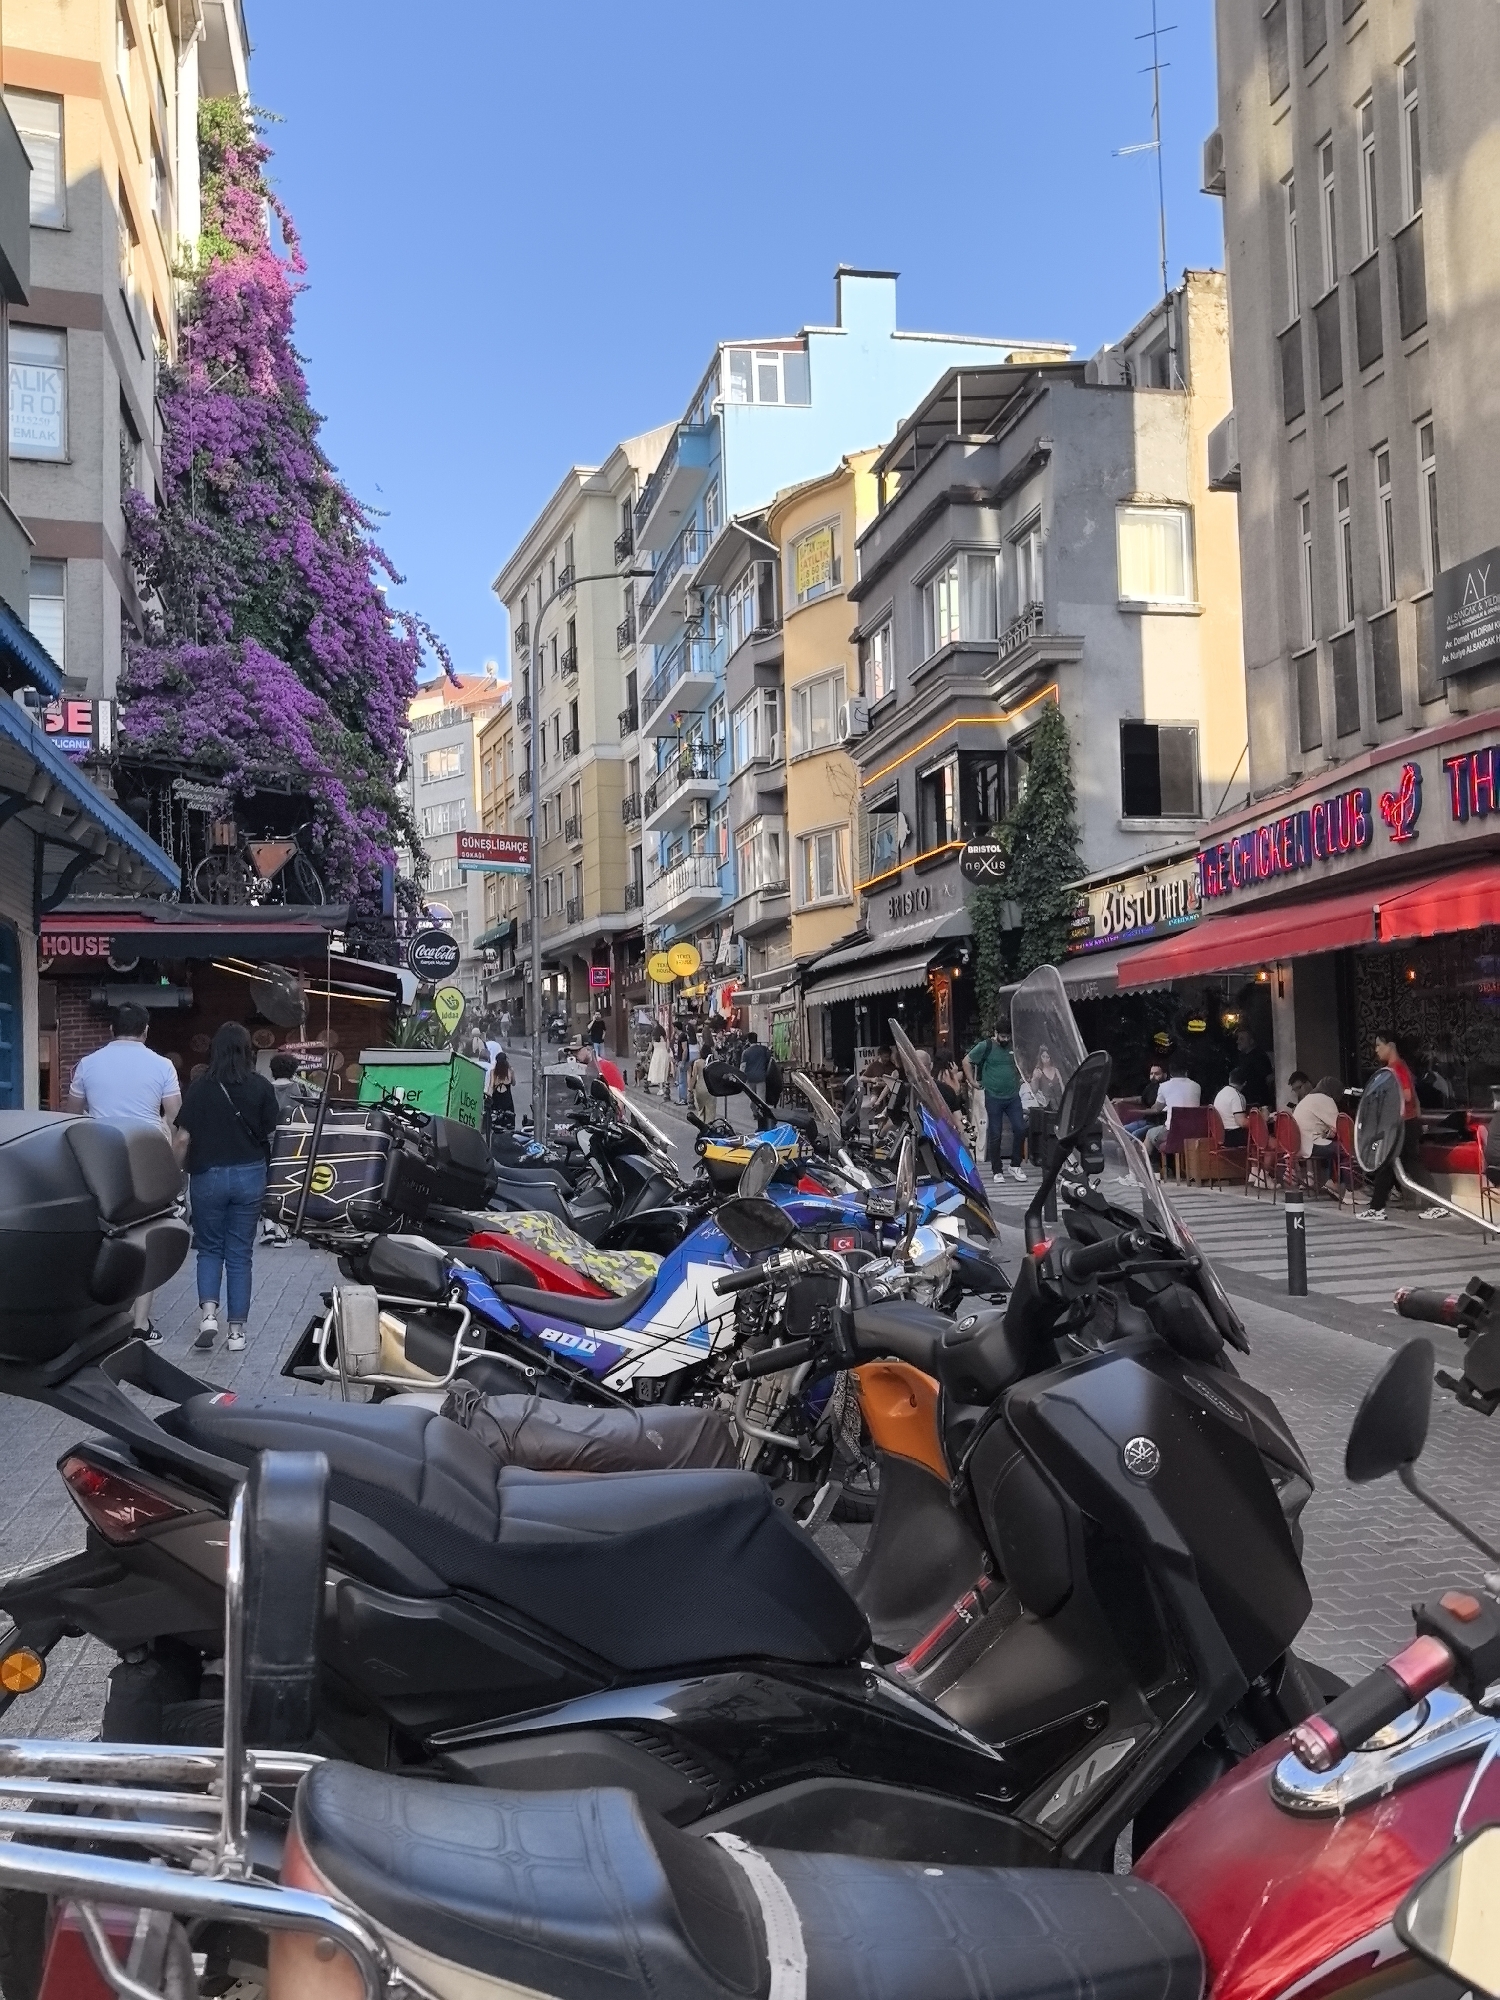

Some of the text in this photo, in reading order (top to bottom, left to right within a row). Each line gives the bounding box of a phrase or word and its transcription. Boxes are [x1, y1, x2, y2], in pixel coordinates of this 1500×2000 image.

[13, 427, 56, 441] EMLAK
[1463, 563, 1491, 606] AY
[1446, 603, 1478, 625] ALSANCAK
[1466, 635, 1496, 655] ALSANCAK
[461, 837, 529, 854] GÜNEŞLİBAHÇE
[967, 844, 1002, 854] BRISTOL
[1196, 787, 1373, 900] THE CHICKEN CLUB
[42, 936, 110, 956] HOUSE
[414, 944, 458, 960] Coca-Cola
[461, 1089, 478, 1111] Uber
[458, 1108, 476, 1128] Eats
[1293, 1216, 1305, 1230] K
[539, 1327, 602, 1353] 800
